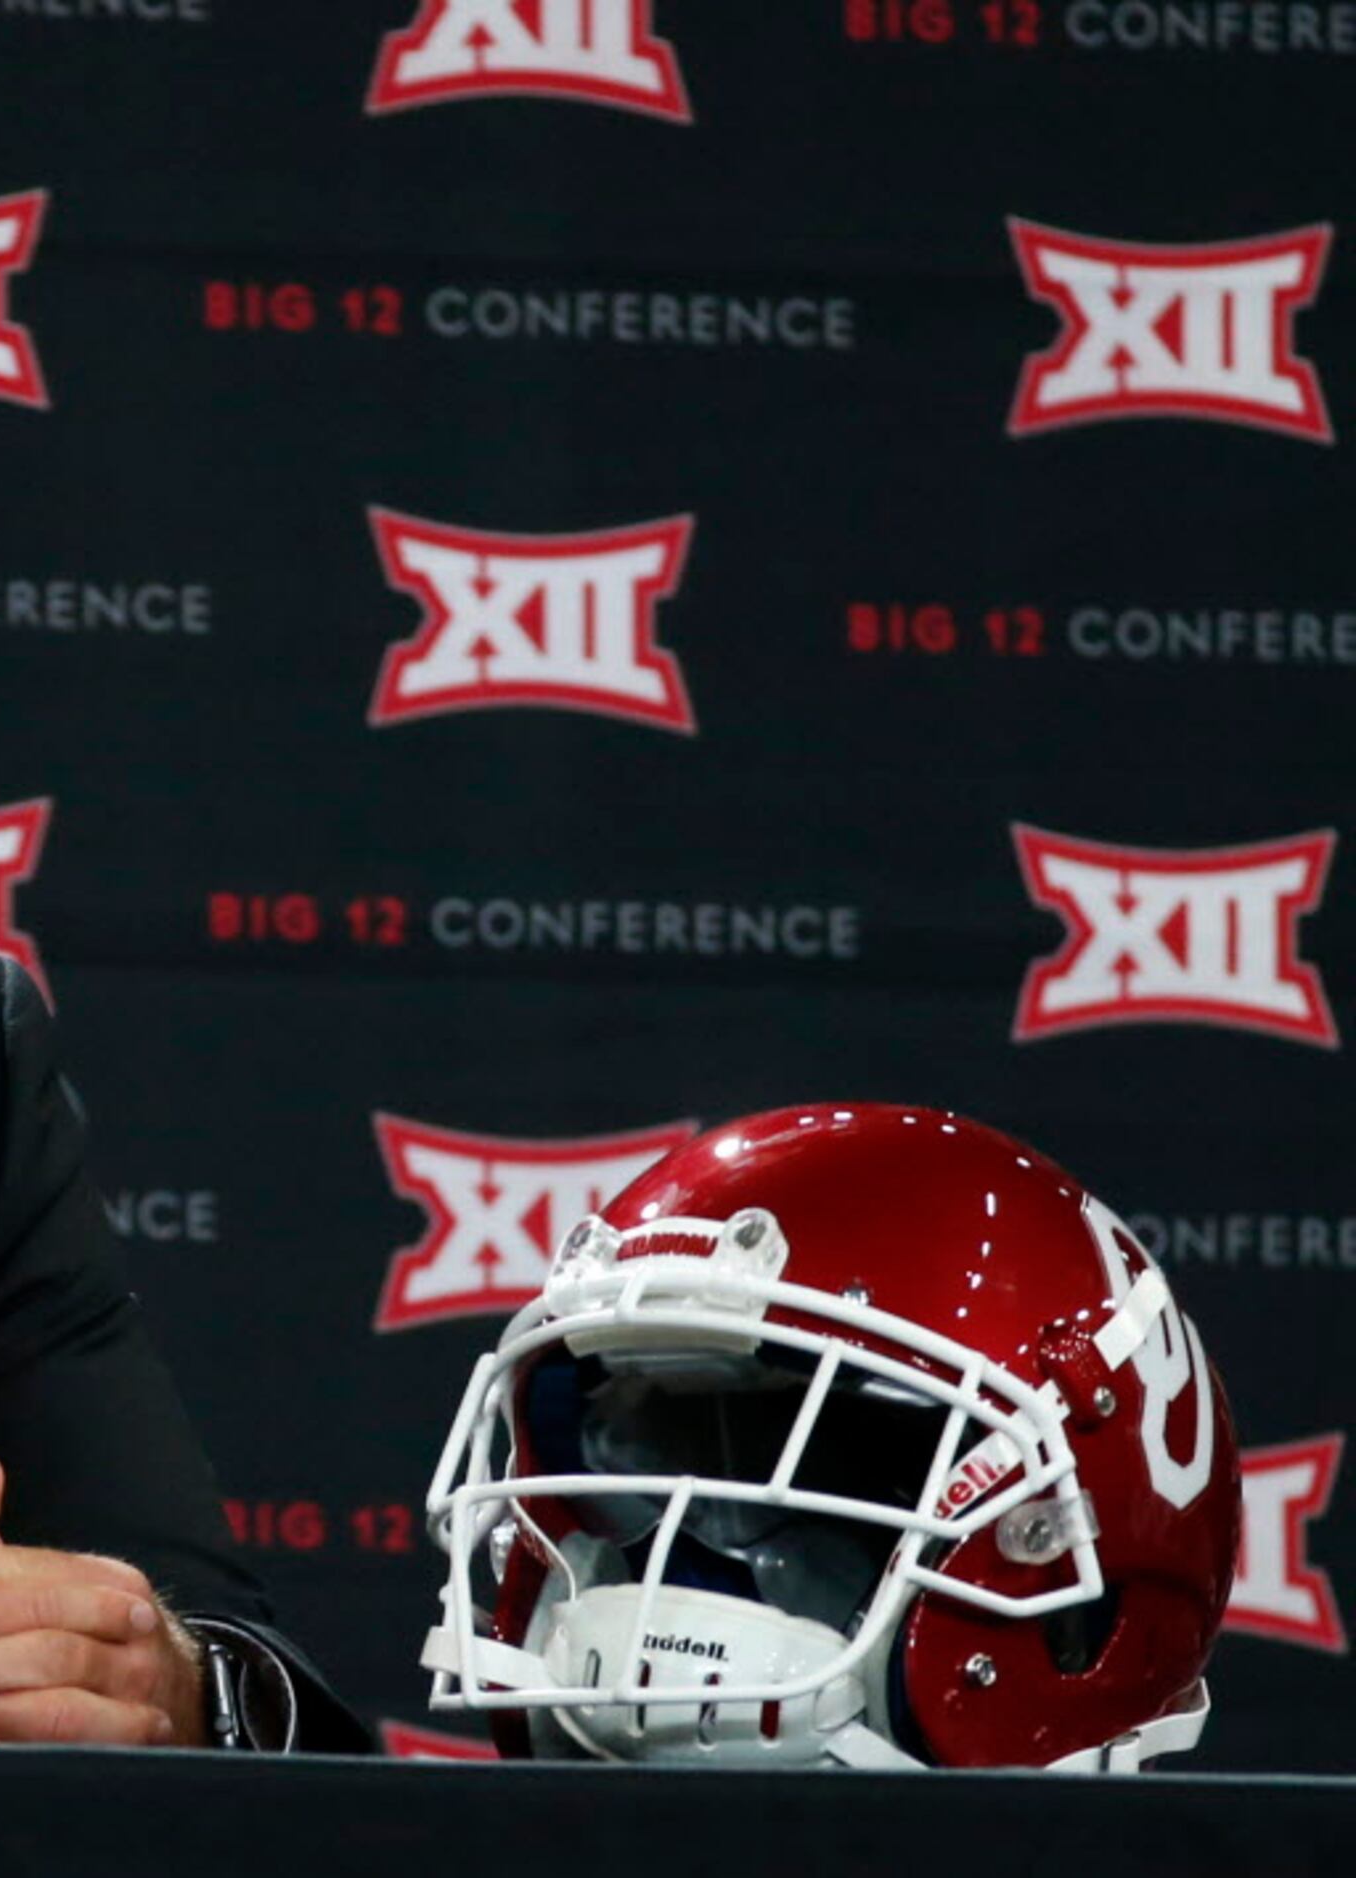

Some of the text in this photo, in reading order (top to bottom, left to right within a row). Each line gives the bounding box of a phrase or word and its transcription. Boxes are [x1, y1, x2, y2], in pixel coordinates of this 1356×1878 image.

[845, 0, 954, 43] BIG
[984, 0, 1041, 45] 12
[204, 282, 856, 348] BIG 12 CONFERENCE
[1025, 236, 1316, 428] XII
[386, 525, 678, 717] XII
[847, 605, 956, 653] BIG
[986, 608, 1043, 656] 12
[209, 892, 861, 957] BIG 12 CONFERENCE
[1030, 843, 1322, 1031] XII
[349, 1503, 413, 1554] 12
